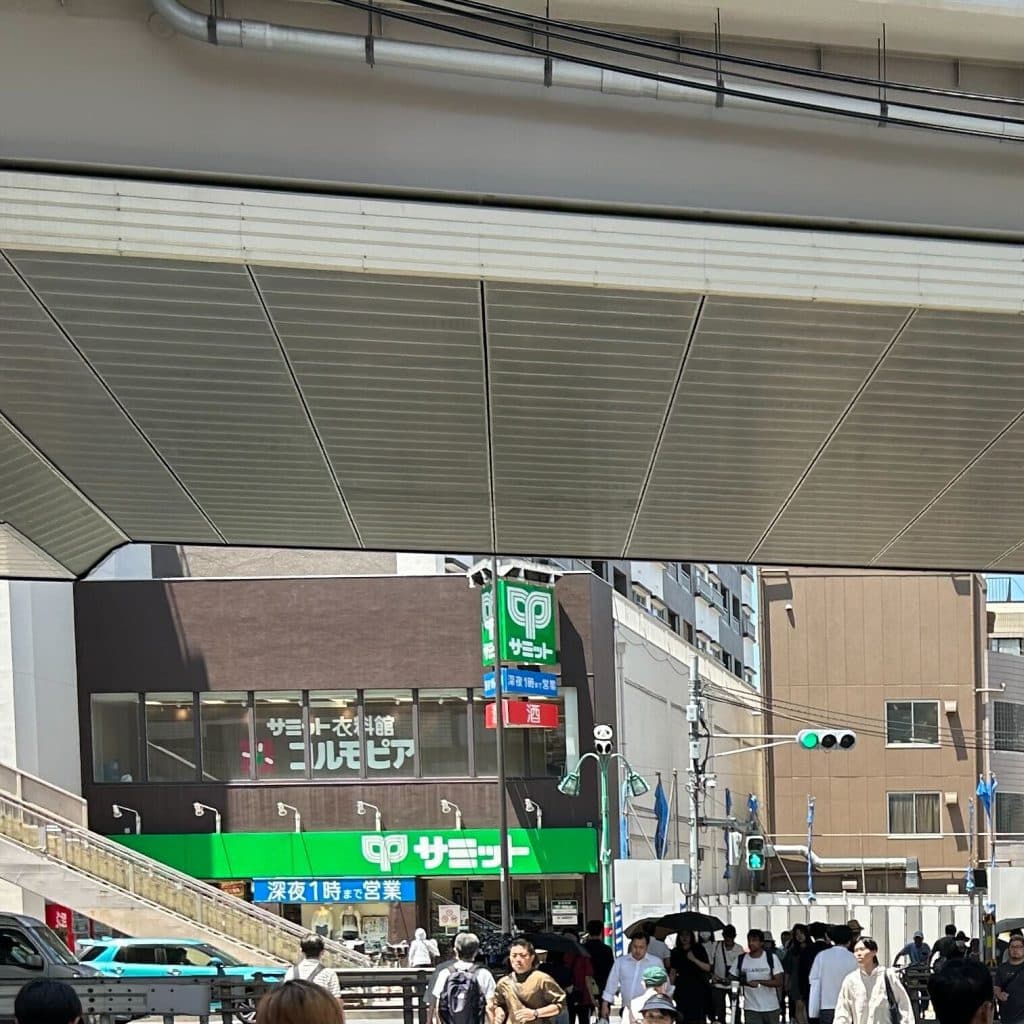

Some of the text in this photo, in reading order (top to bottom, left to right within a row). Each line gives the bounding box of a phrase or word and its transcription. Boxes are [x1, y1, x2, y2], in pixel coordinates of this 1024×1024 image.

[508, 637, 554, 660] サミット
[526, 704, 541, 723] 酒
[413, 835, 530, 870] サミット
[267, 880, 402, 901] 深夜1時まで営業
